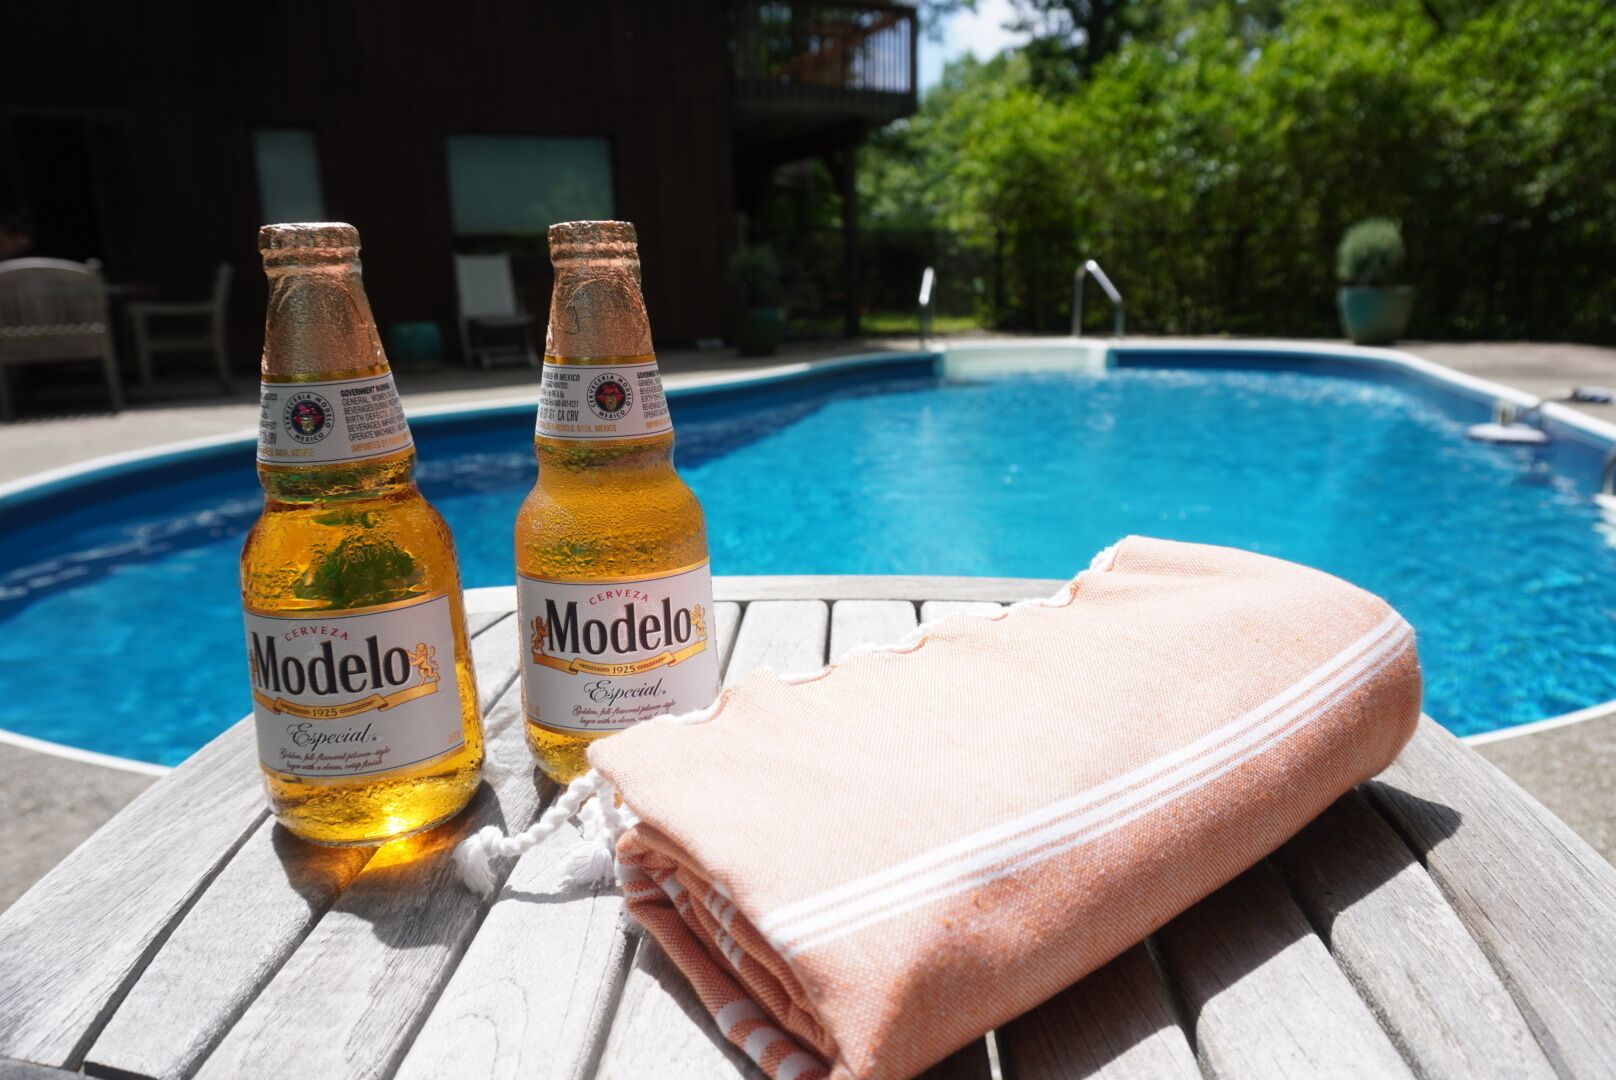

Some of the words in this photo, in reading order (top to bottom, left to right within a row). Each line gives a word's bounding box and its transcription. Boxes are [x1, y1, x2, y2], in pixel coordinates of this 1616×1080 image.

[560, 373, 580, 382] MEXICO
[340, 385, 375, 397] GOVERNMENT
[588, 375, 614, 408] CERVECERIA
[286, 394, 311, 430] CERVECERIA
[314, 396, 333, 429] MODELO
[343, 403, 375, 415] BEVERAGES
[598, 410, 625, 420] MEXICO
[345, 413, 364, 424] BIRTH
[567, 410, 579, 422] CRV
[347, 420, 381, 433] BEVERAGES
[295, 432, 324, 443] MEXICO
[348, 430, 374, 441] OPERATE
[588, 589, 649, 606] CERVEZA
[545, 596, 692, 656] Modelo
[284, 625, 351, 642] CERVEZA
[251, 631, 412, 697] Modelo
[612, 665, 636, 674] 1925
[312, 708, 338, 717] 1925
